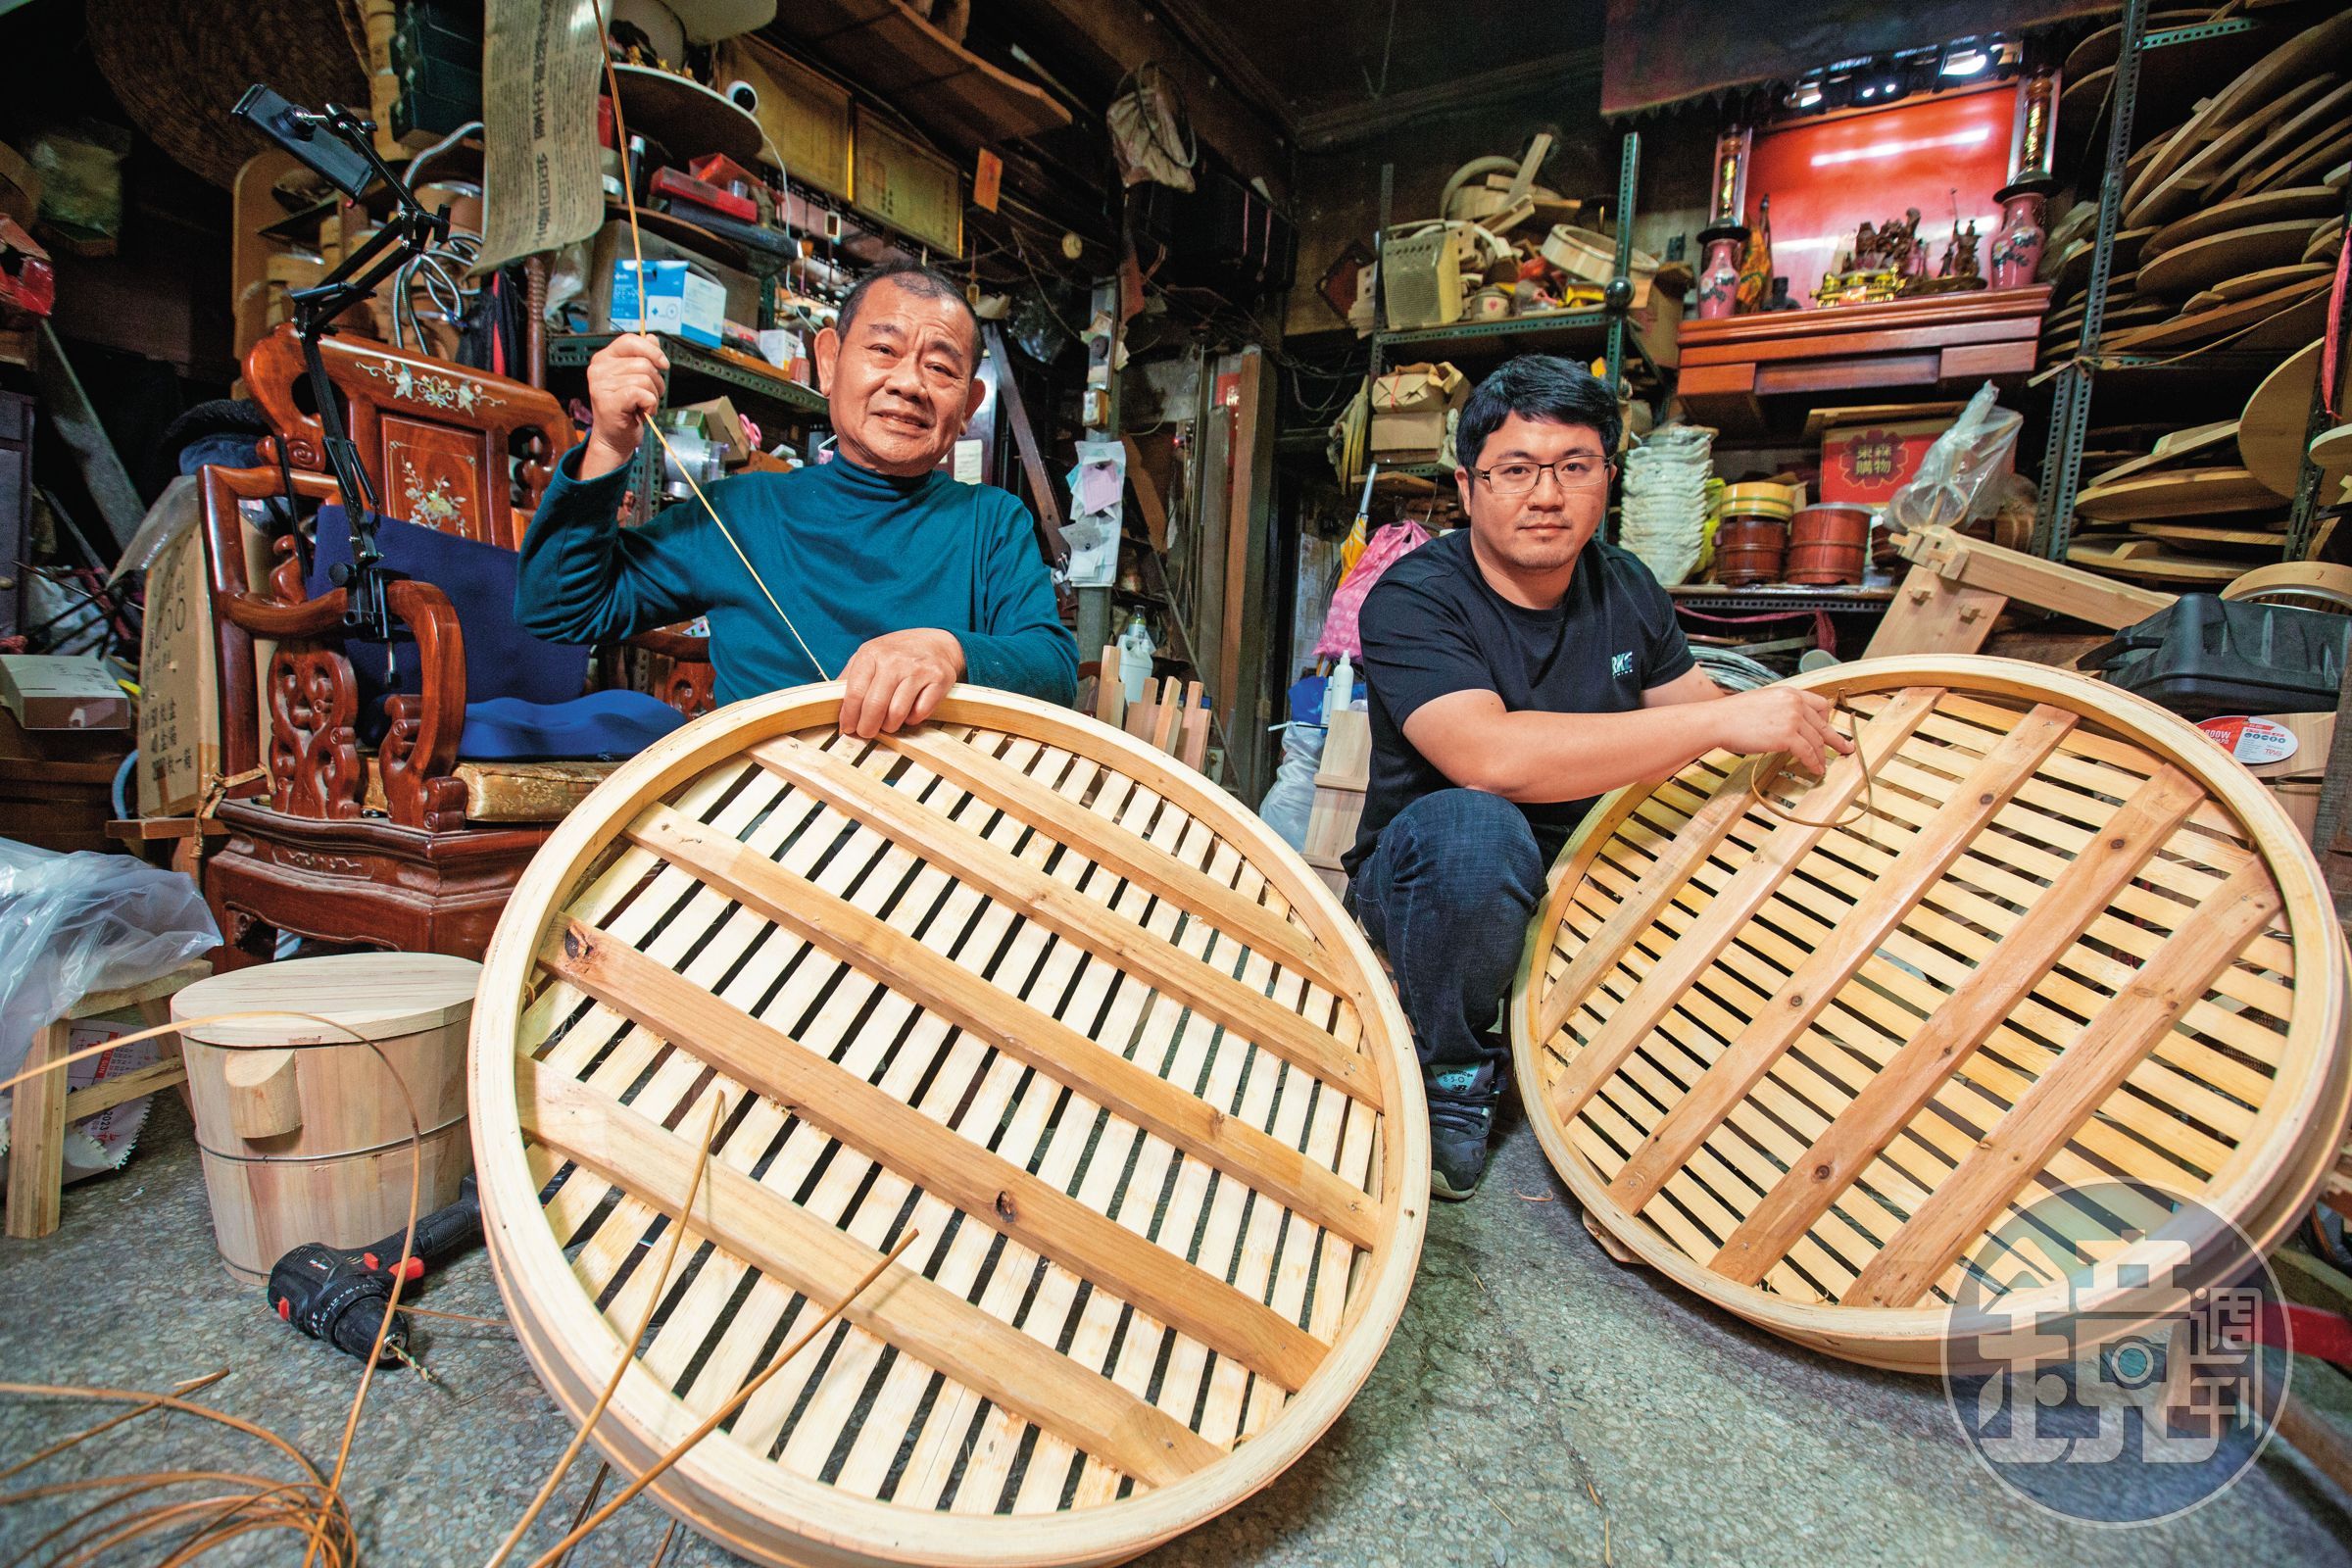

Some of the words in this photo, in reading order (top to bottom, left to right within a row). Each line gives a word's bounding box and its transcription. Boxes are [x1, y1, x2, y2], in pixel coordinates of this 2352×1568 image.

[1857, 445, 1890, 459] 東森
[1856, 461, 1891, 474] 購物
[99, 1110, 114, 1131] 2023
